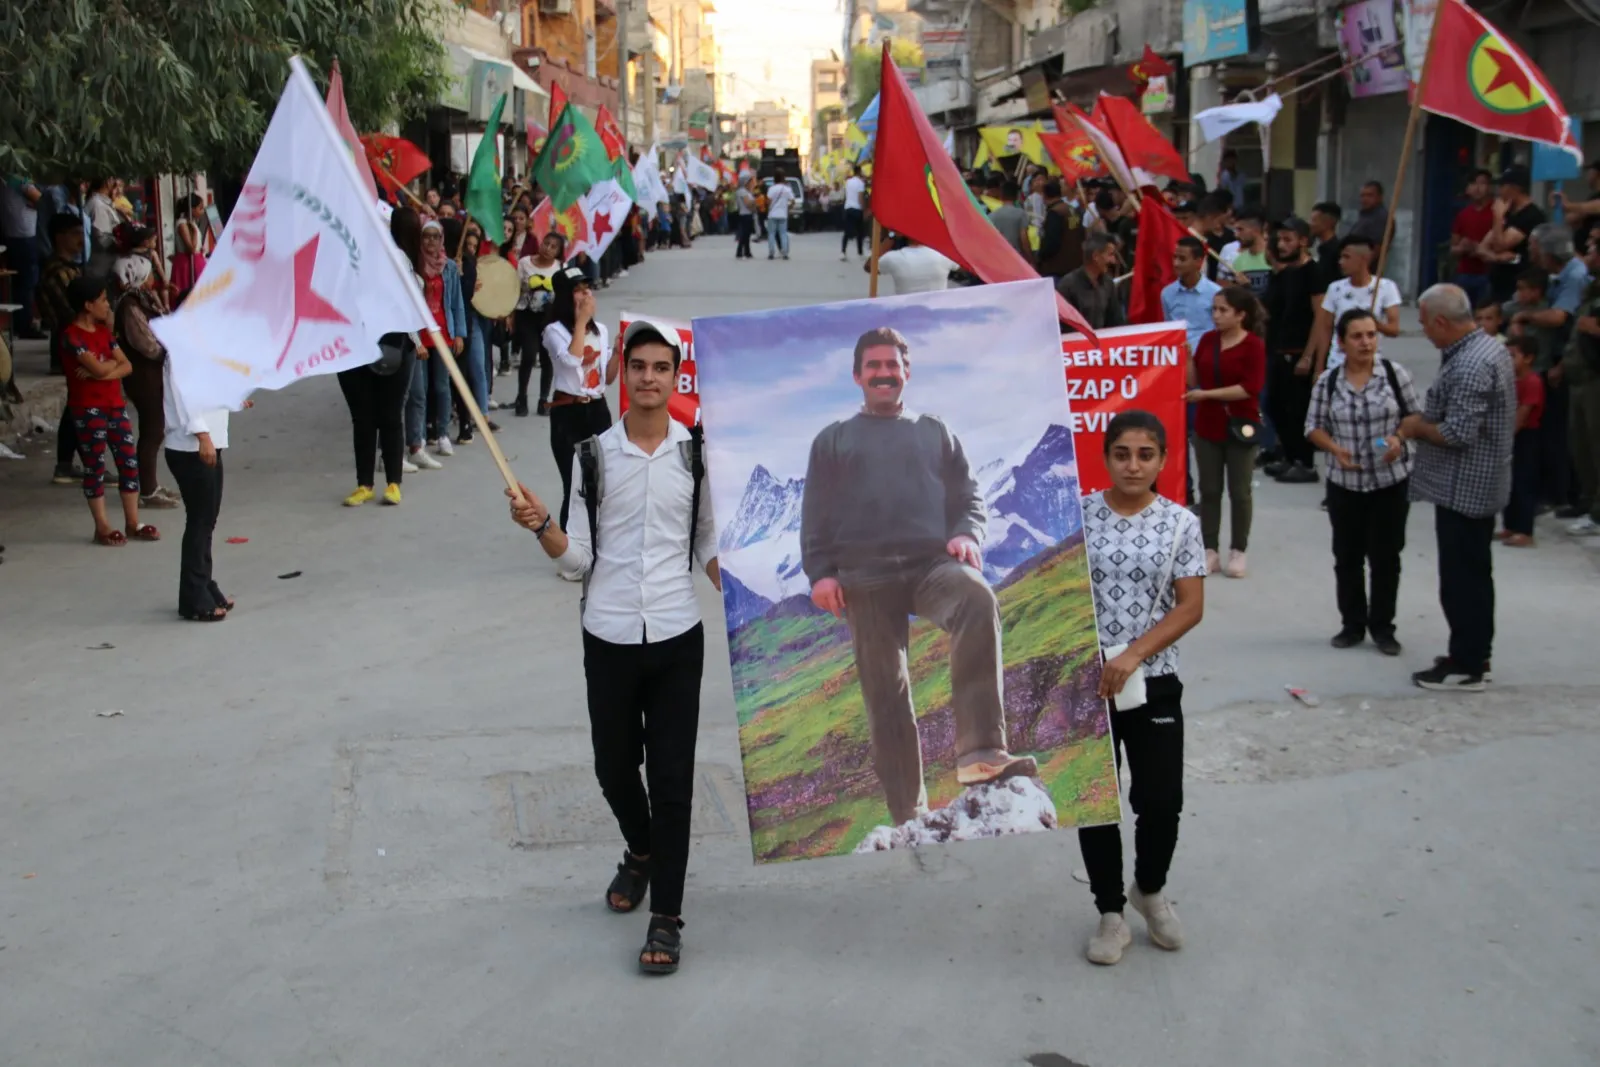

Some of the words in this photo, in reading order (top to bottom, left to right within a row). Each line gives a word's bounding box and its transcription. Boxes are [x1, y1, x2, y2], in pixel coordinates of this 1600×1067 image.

[1109, 346, 1178, 366] KETIN
[1068, 379, 1114, 400] ZAP
[1121, 374, 1138, 399] Û
[1071, 412, 1116, 432] EVI
